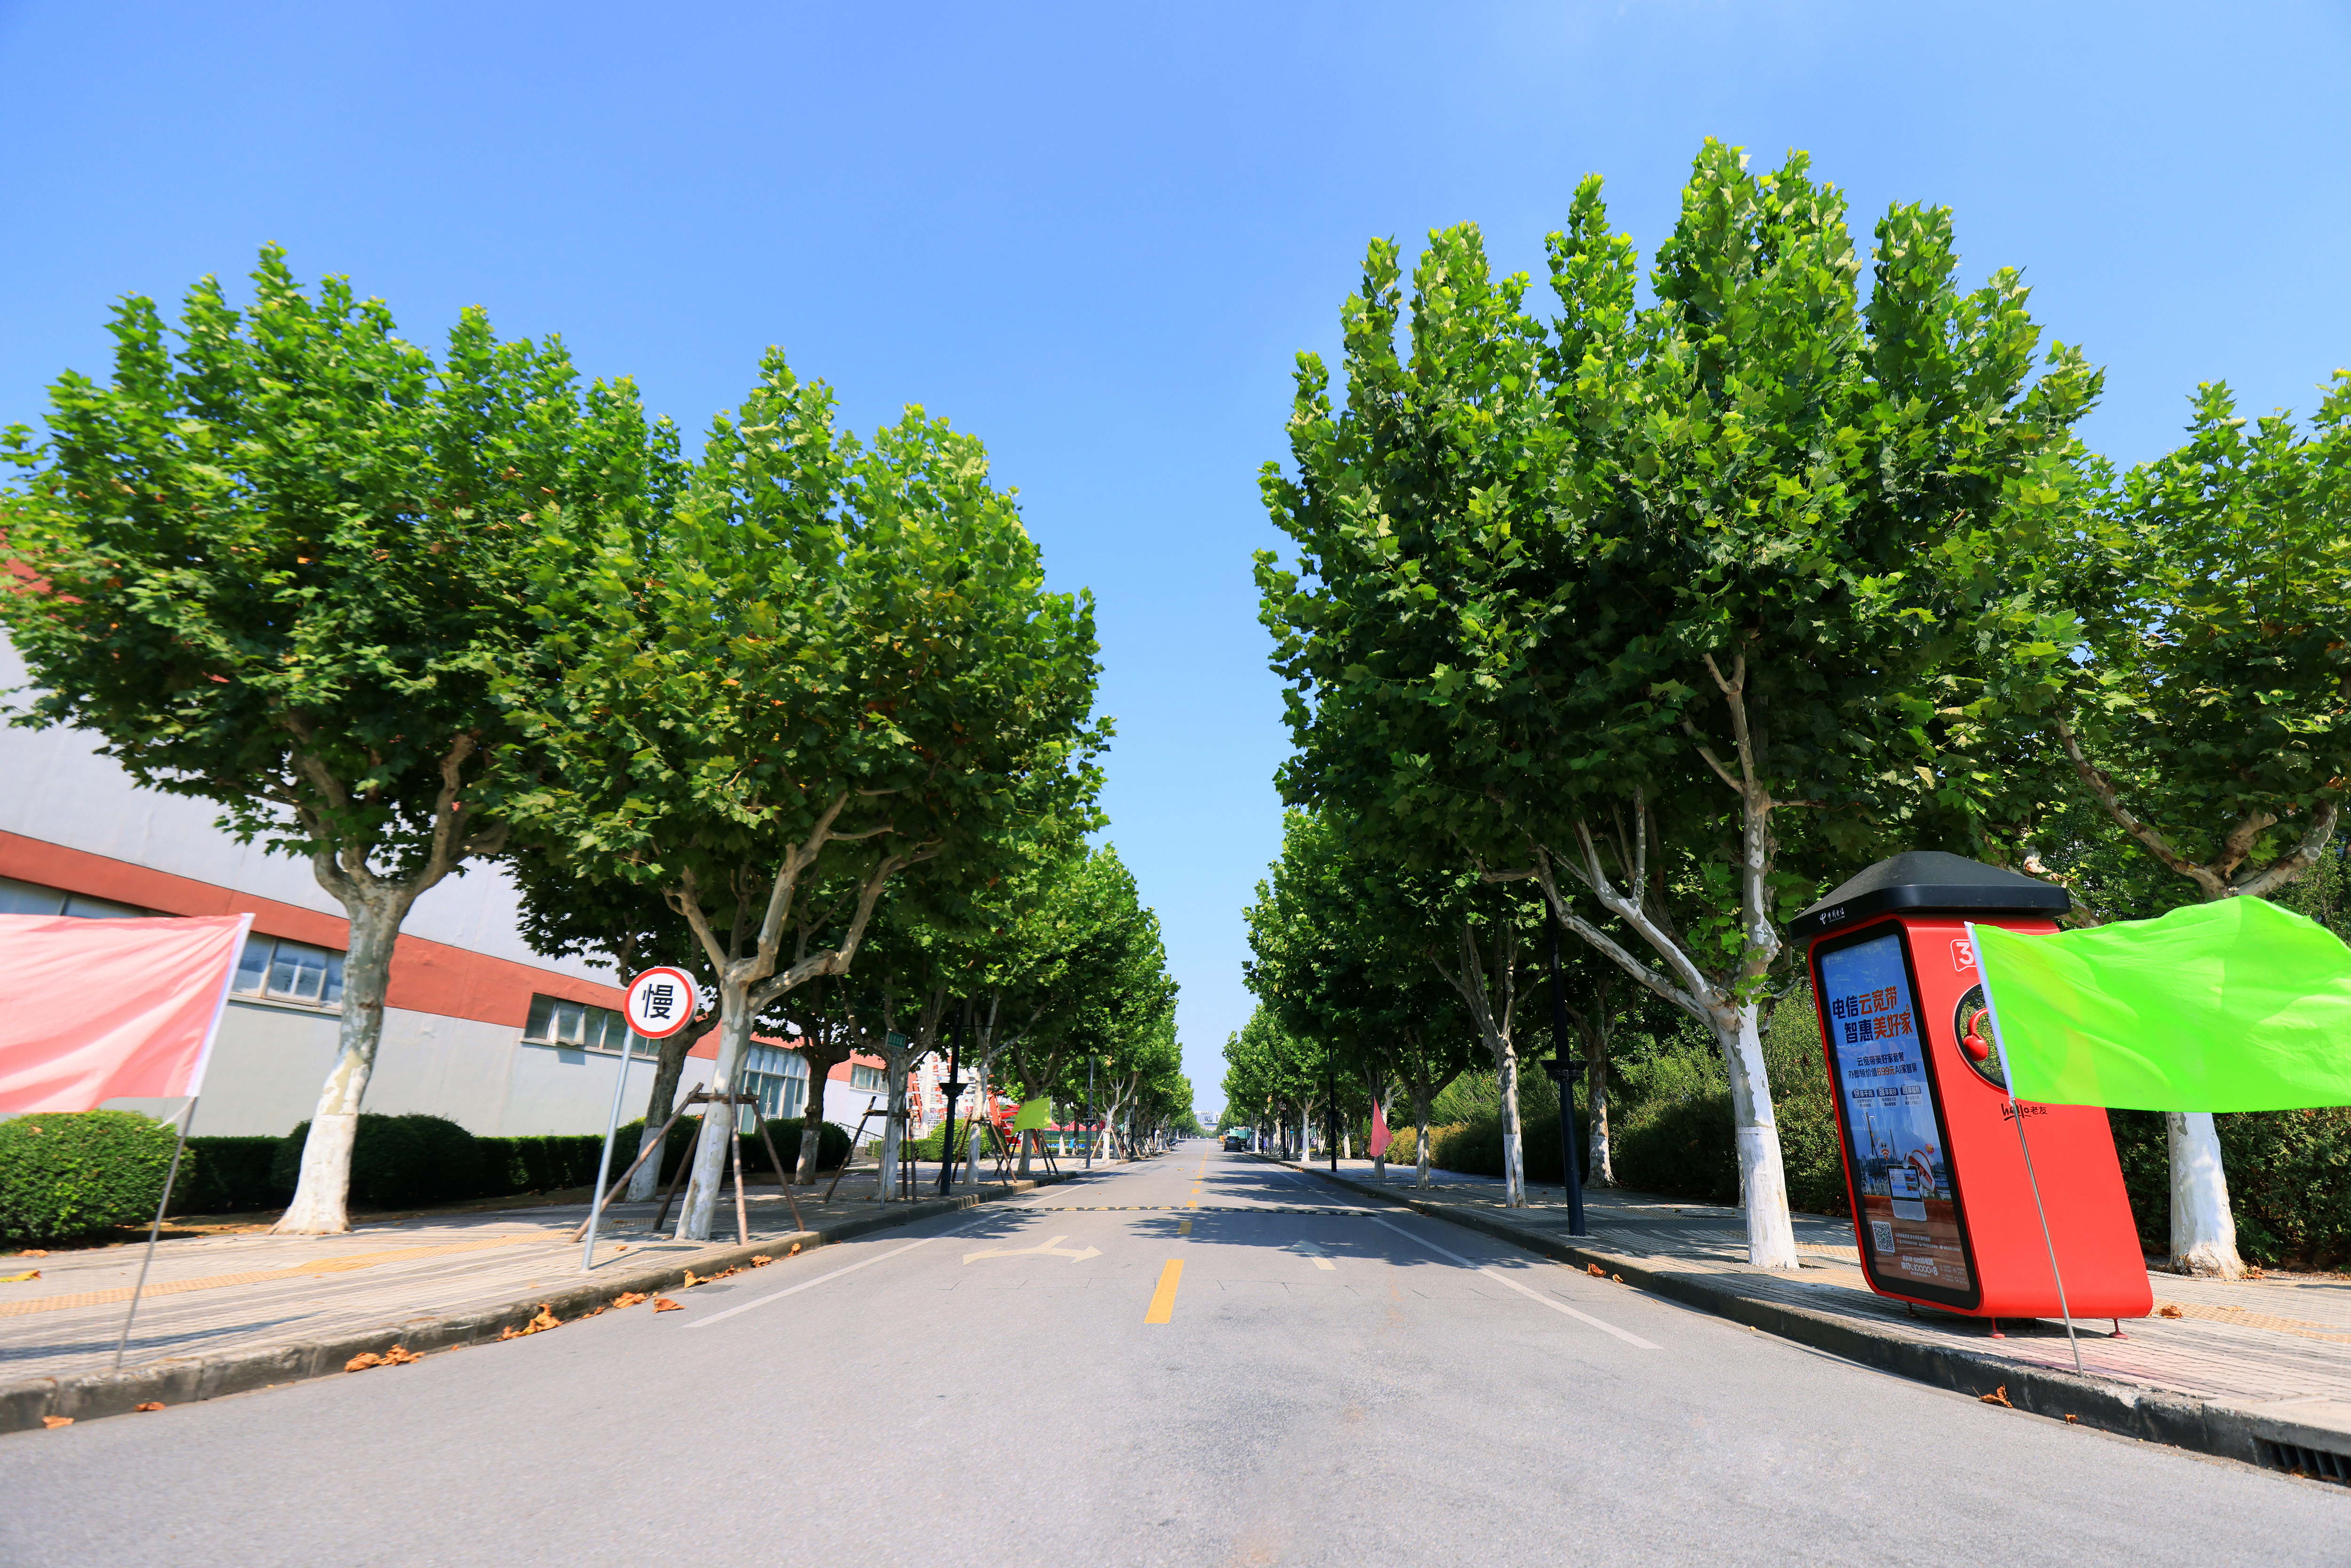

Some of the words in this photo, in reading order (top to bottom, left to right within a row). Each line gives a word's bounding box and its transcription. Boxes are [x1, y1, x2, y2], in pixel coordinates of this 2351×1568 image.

[641, 984, 673, 1019] 慢
[1832, 986, 1897, 1019] 电信云宽带
[1844, 1011, 1913, 1044] 智惠美好家
[1857, 1052, 1905, 1066] 云宽带美好家套餐
[1848, 1063, 1917, 1079] 办即领价值699元AI家智屏
[1854, 1089, 1873, 1097] 快享千兆
[1879, 1087, 1896, 1096] 智享美好
